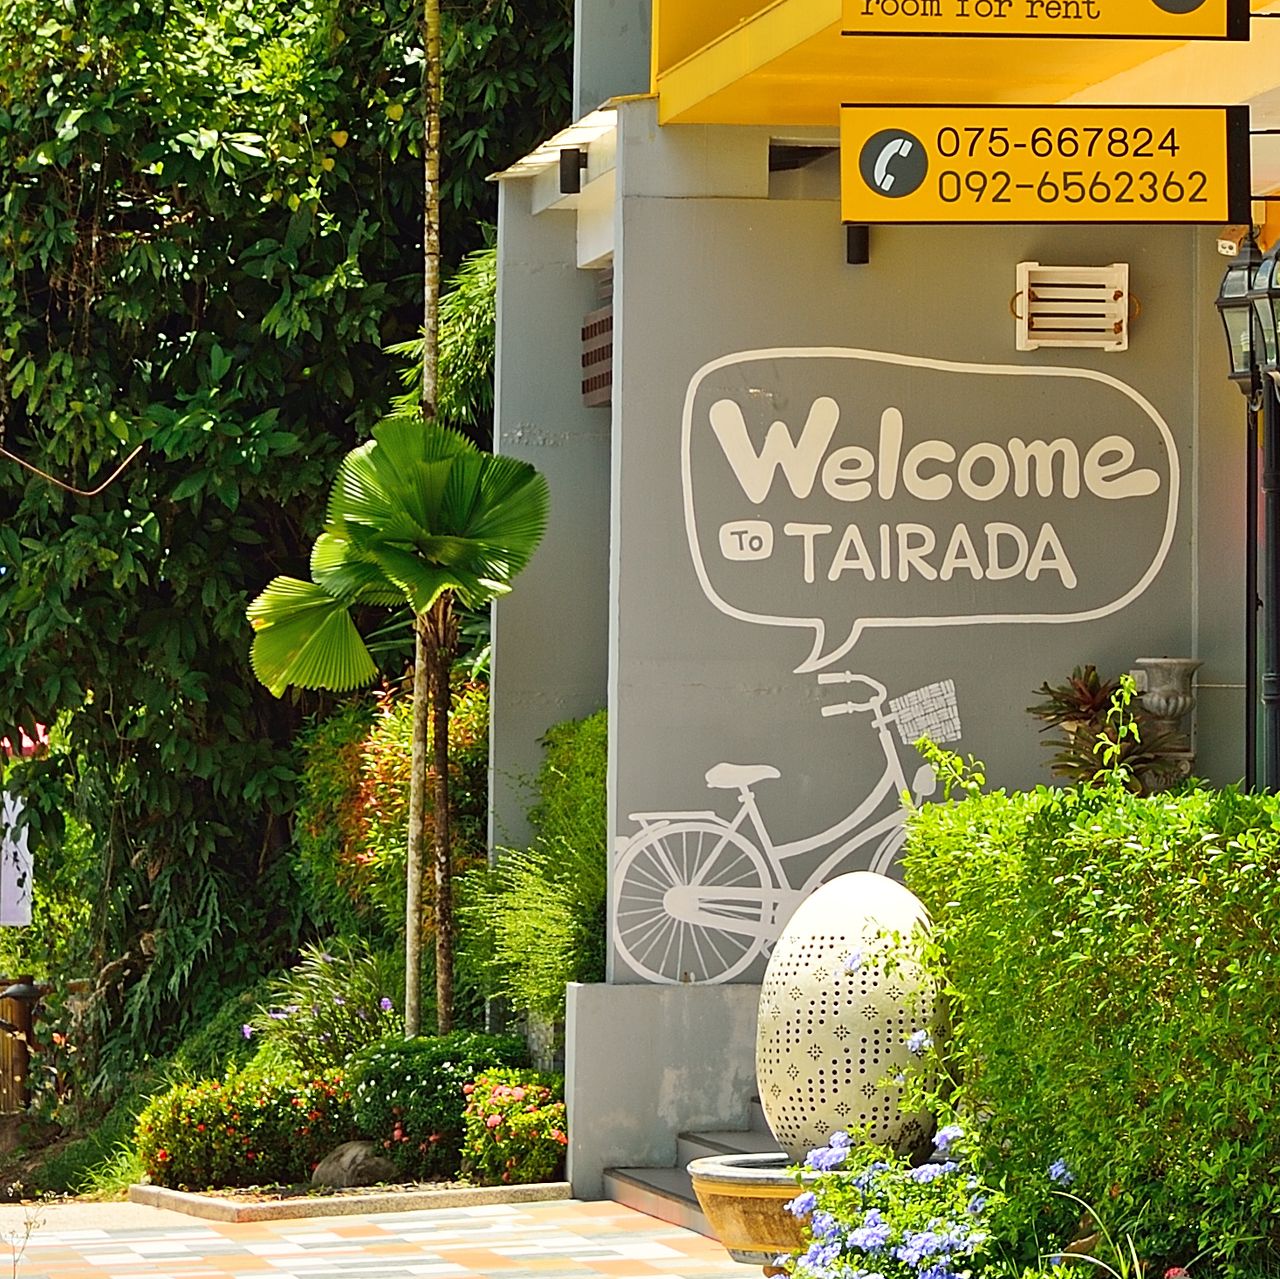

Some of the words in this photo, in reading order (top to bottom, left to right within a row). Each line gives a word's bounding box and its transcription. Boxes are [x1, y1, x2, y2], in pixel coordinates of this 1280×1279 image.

[937, 126, 1180, 158] 075-667824
[938, 170, 1208, 203] 092-6562362
[709, 396, 1160, 504] Welcome
[730, 530, 763, 552] To
[784, 522, 1077, 589] TAIRADA
